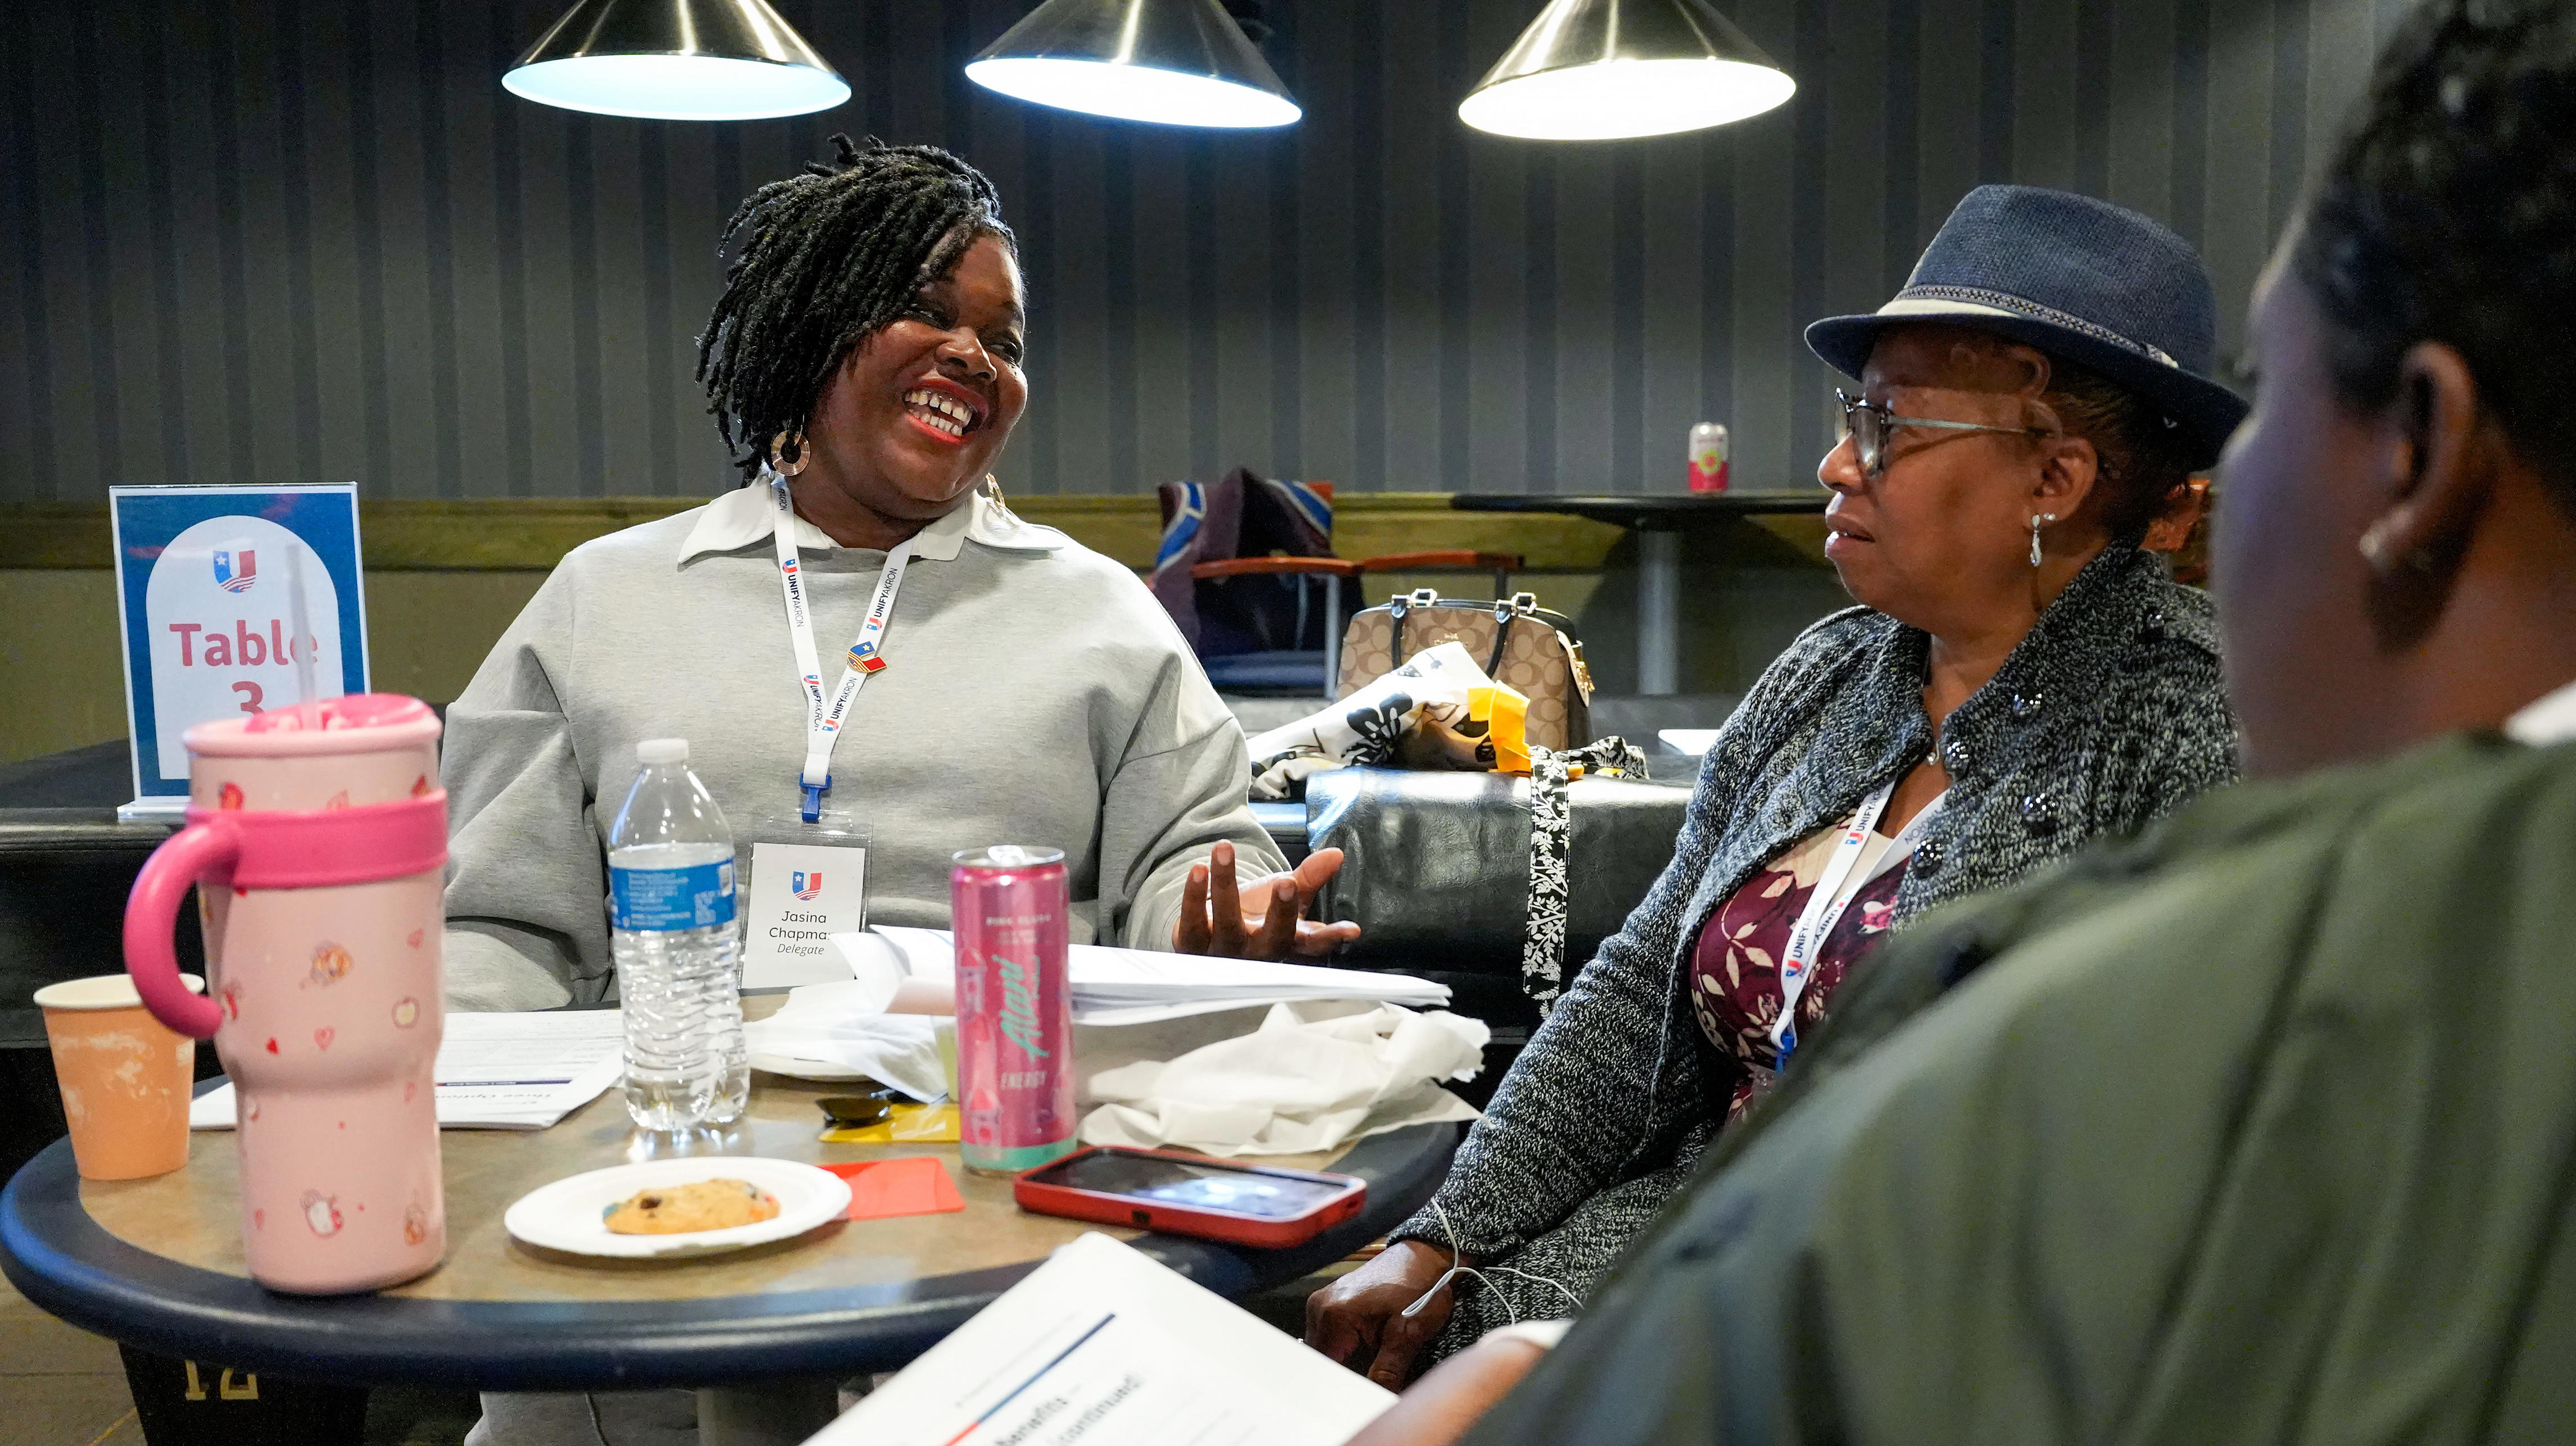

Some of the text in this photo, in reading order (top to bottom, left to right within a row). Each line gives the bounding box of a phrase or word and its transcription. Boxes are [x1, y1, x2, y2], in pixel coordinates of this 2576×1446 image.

[788, 574, 804, 627] UNIFYAKRON
[874, 567, 898, 617] UNIFYAKRON
[232, 680, 264, 717] 3
[831, 677, 858, 719] UNIFYAKRON
[769, 927, 831, 942] Chapma
[782, 911, 827, 924] Jasina
[777, 943, 825, 956] Delegate
